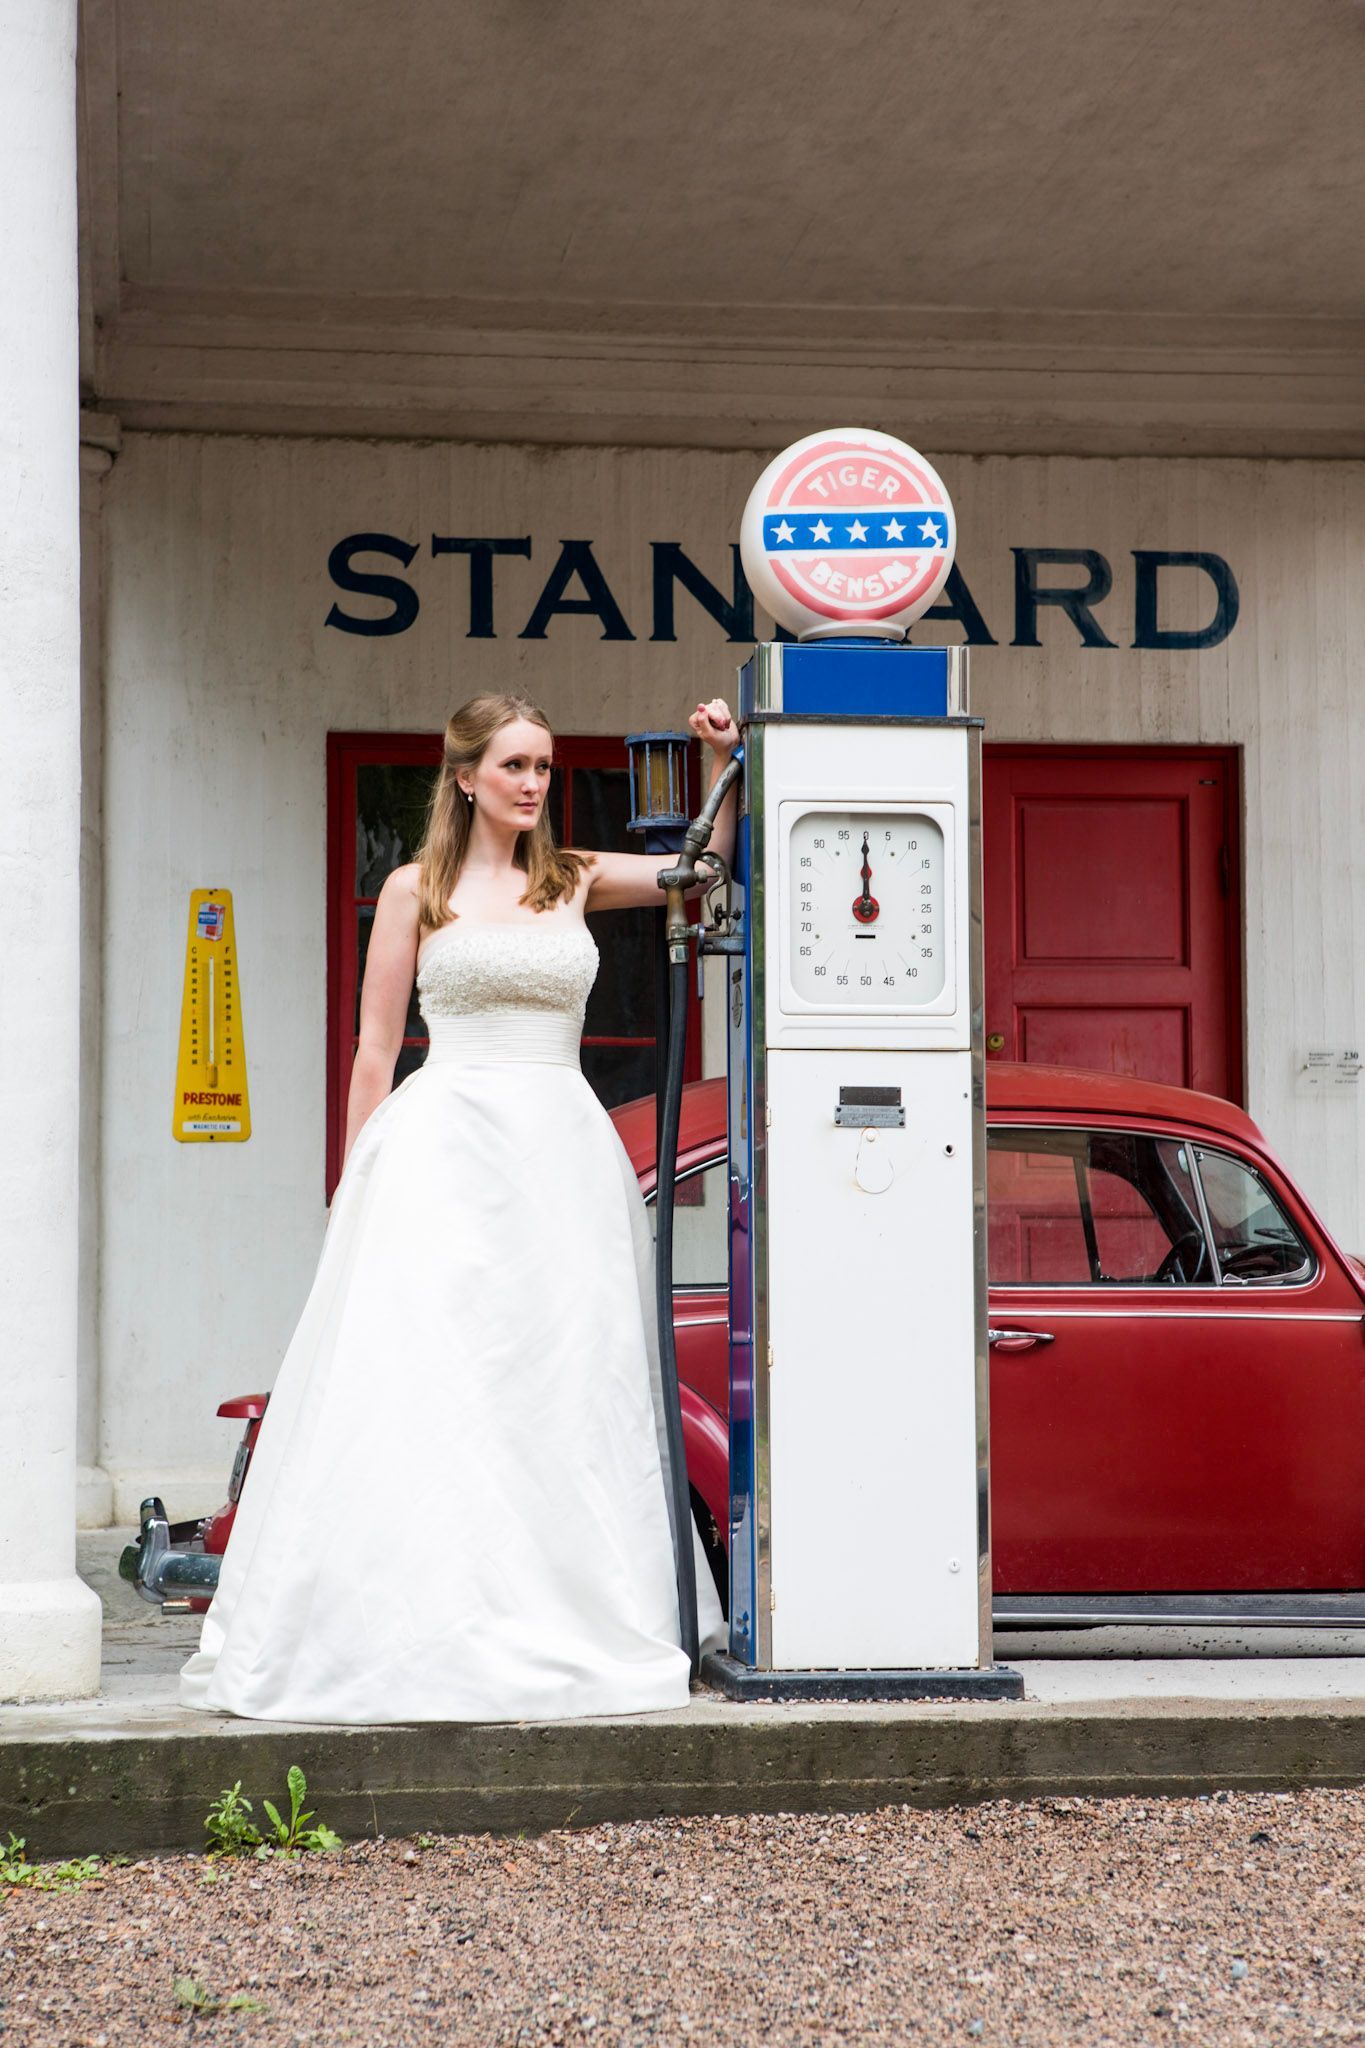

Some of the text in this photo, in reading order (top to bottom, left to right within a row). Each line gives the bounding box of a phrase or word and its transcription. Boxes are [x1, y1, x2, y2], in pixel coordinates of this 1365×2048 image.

[807, 465, 901, 500] TIGER
[324, 532, 1240, 650] STANARD
[837, 830, 850, 841] 95
[884, 831, 892, 841] 5
[813, 839, 825, 849] 90
[907, 841, 917, 850] 10
[800, 858, 812, 868] 85
[921, 859, 931, 869] 15
[800, 883, 812, 893] 80
[920, 885, 932, 895] 20
[800, 902, 812, 912] 75
[921, 904, 932, 914] 25
[801, 922, 812, 932] 70
[921, 924, 932, 934] 30
[800, 946, 812, 956] 65
[921, 948, 933, 958] 35
[814, 966, 826, 976] 60
[905, 968, 918, 978] 40
[836, 975, 849, 985] 55
[860, 976, 872, 986] 50
[883, 976, 895, 986] 45
[183, 1092, 242, 1106] PRESTONE
